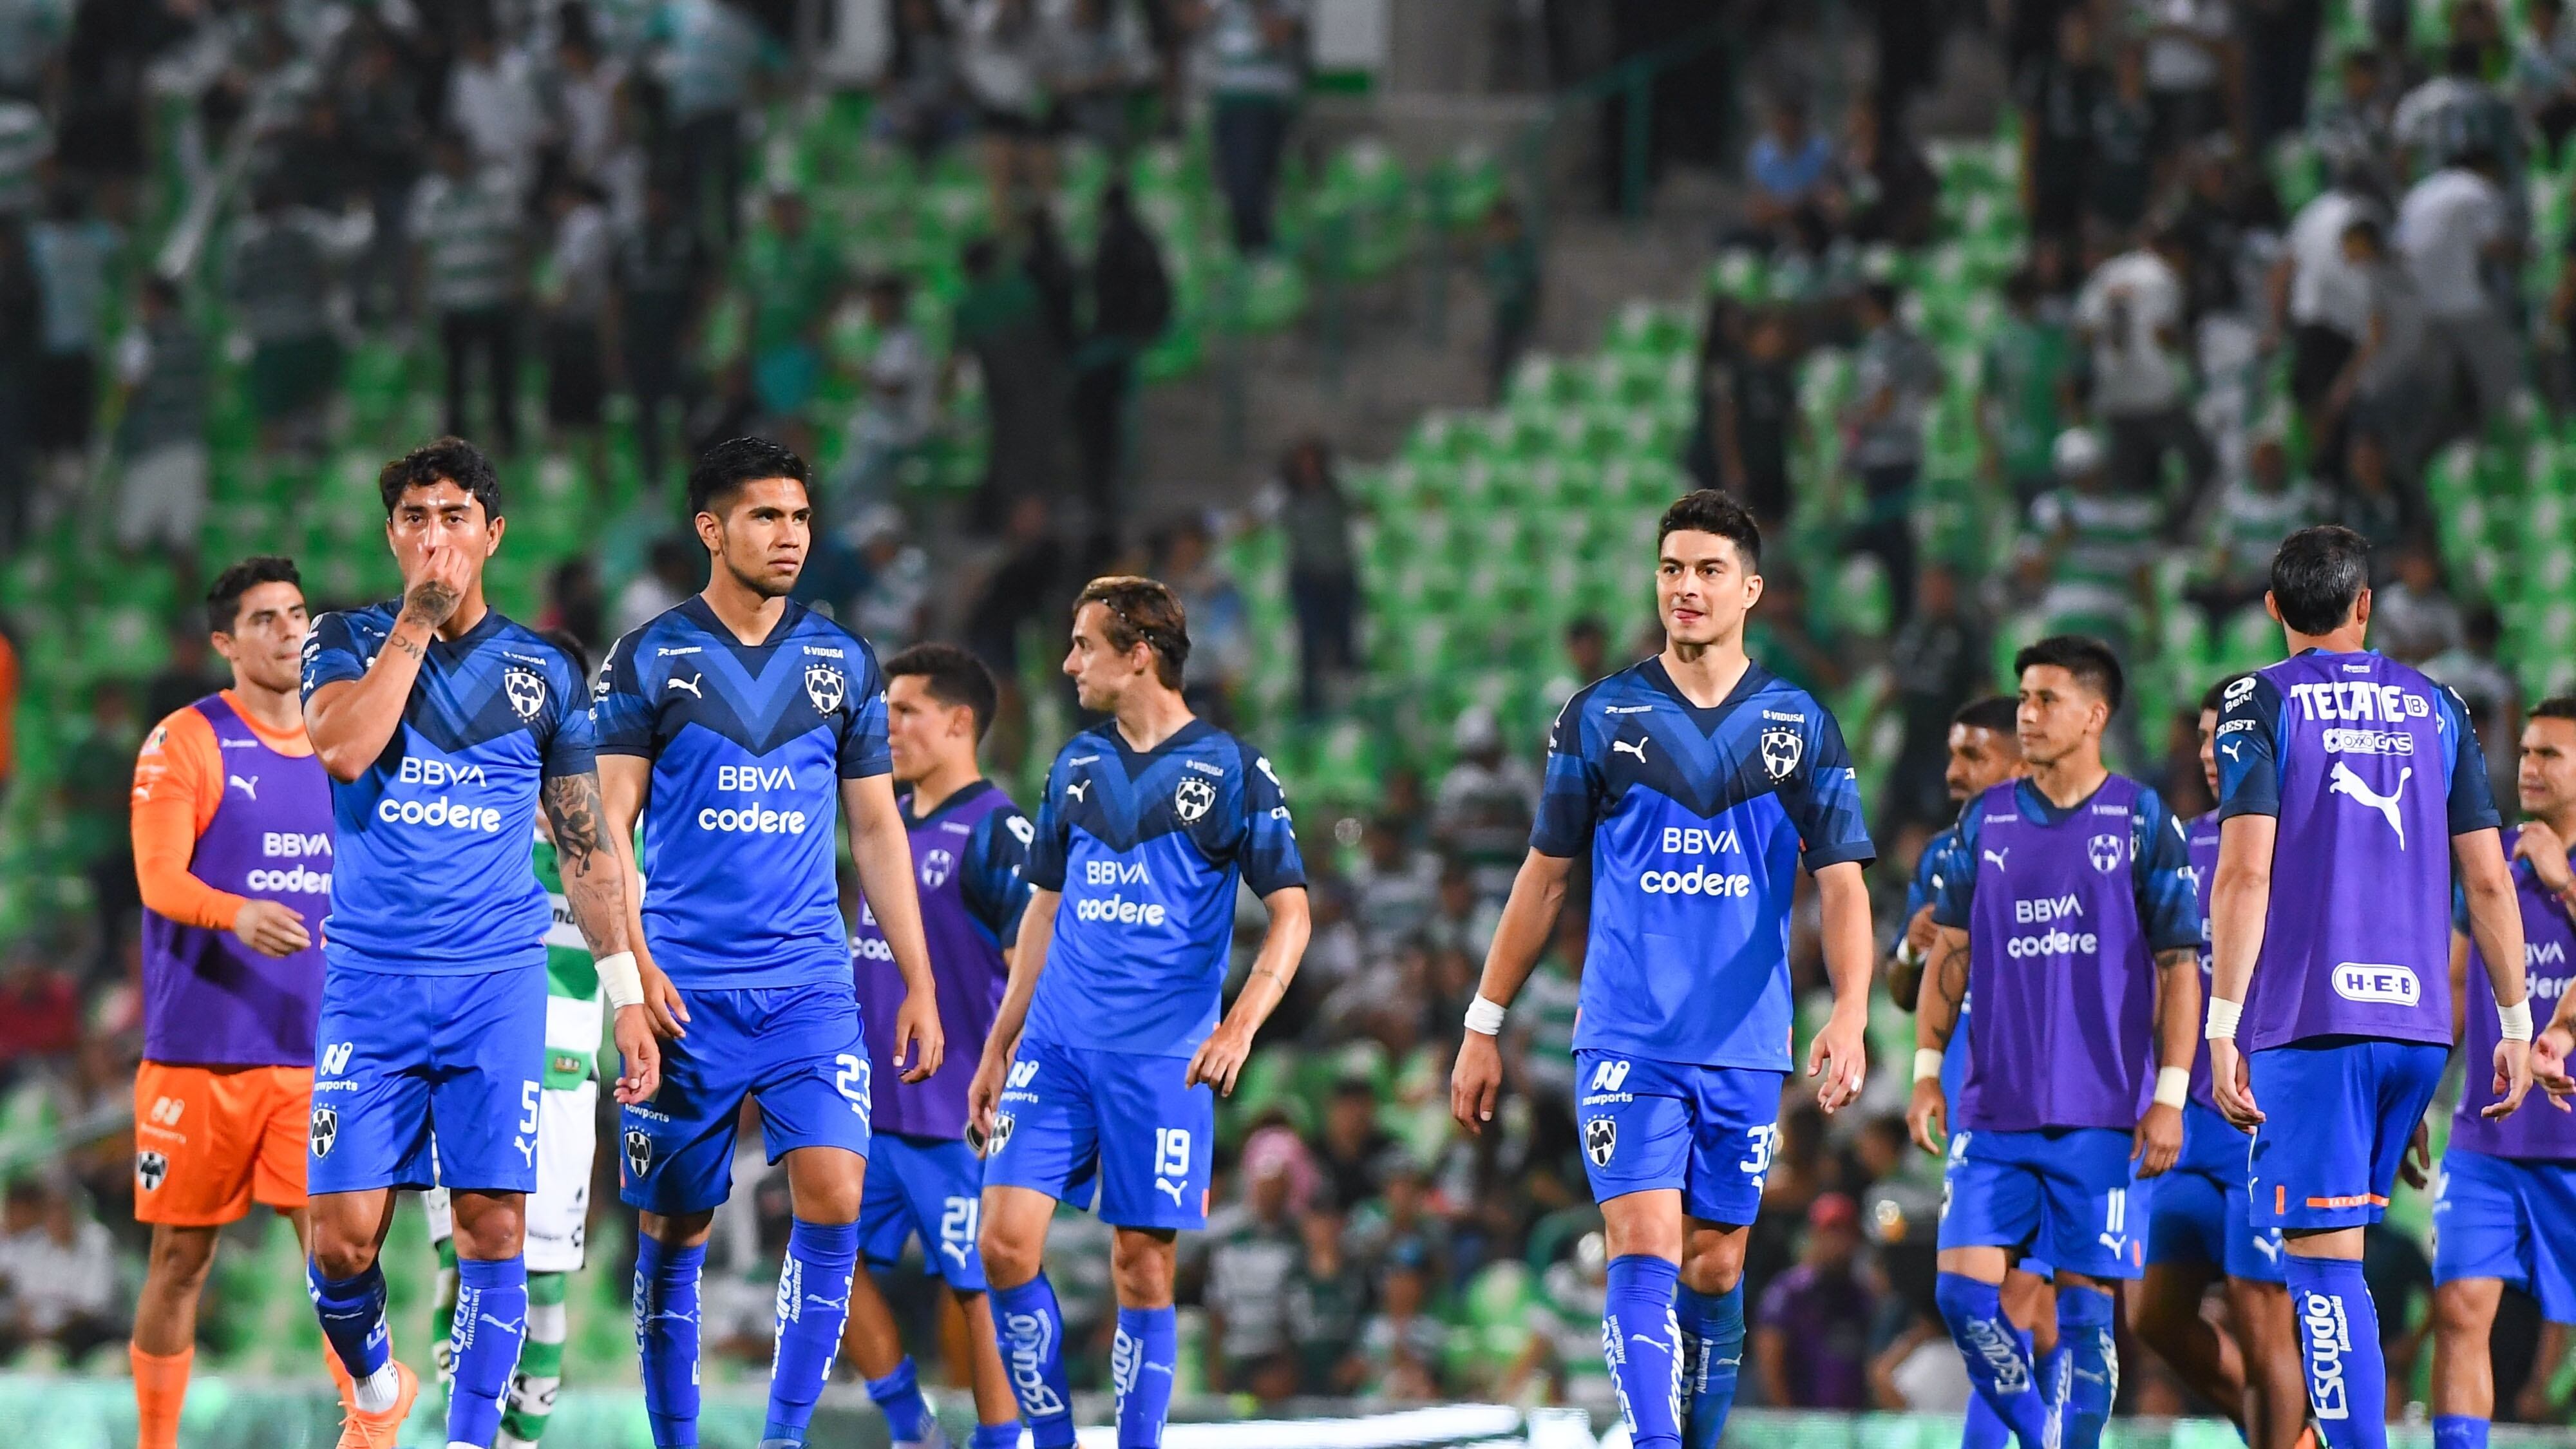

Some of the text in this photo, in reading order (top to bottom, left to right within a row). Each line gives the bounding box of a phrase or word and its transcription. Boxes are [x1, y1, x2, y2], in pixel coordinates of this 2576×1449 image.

[811, 647, 844, 659] VIDUSA
[1771, 711, 1804, 723] VIDUSA
[2290, 681, 2405, 723] TECATE
[2344, 734, 2411, 751] OXXO GAS
[399, 756, 487, 787] BBVA
[718, 765, 796, 792] BBVA
[379, 795, 501, 833] codere
[698, 802, 806, 835] codere
[263, 831, 332, 858] BBVA
[1662, 827, 1740, 855] BBVA
[246, 863, 332, 895] coder
[1086, 860, 1150, 886] BBVA
[1640, 864, 1750, 897] codere
[1077, 893, 1165, 926] codere
[2016, 893, 2083, 923] BBVA
[2007, 928, 2098, 958] codere
[836, 1054, 872, 1110] 23
[520, 1080, 540, 1133] 5
[1582, 1092, 1633, 1106] nowports
[1155, 1128, 1190, 1177] 19
[941, 1197, 979, 1242] 21
[2106, 1188, 2126, 1233] 11
[1608, 1314, 1627, 1365] Antibacterial
[1004, 1314, 1065, 1416] Escudo
[2304, 1294, 2349, 1420] Escudo
